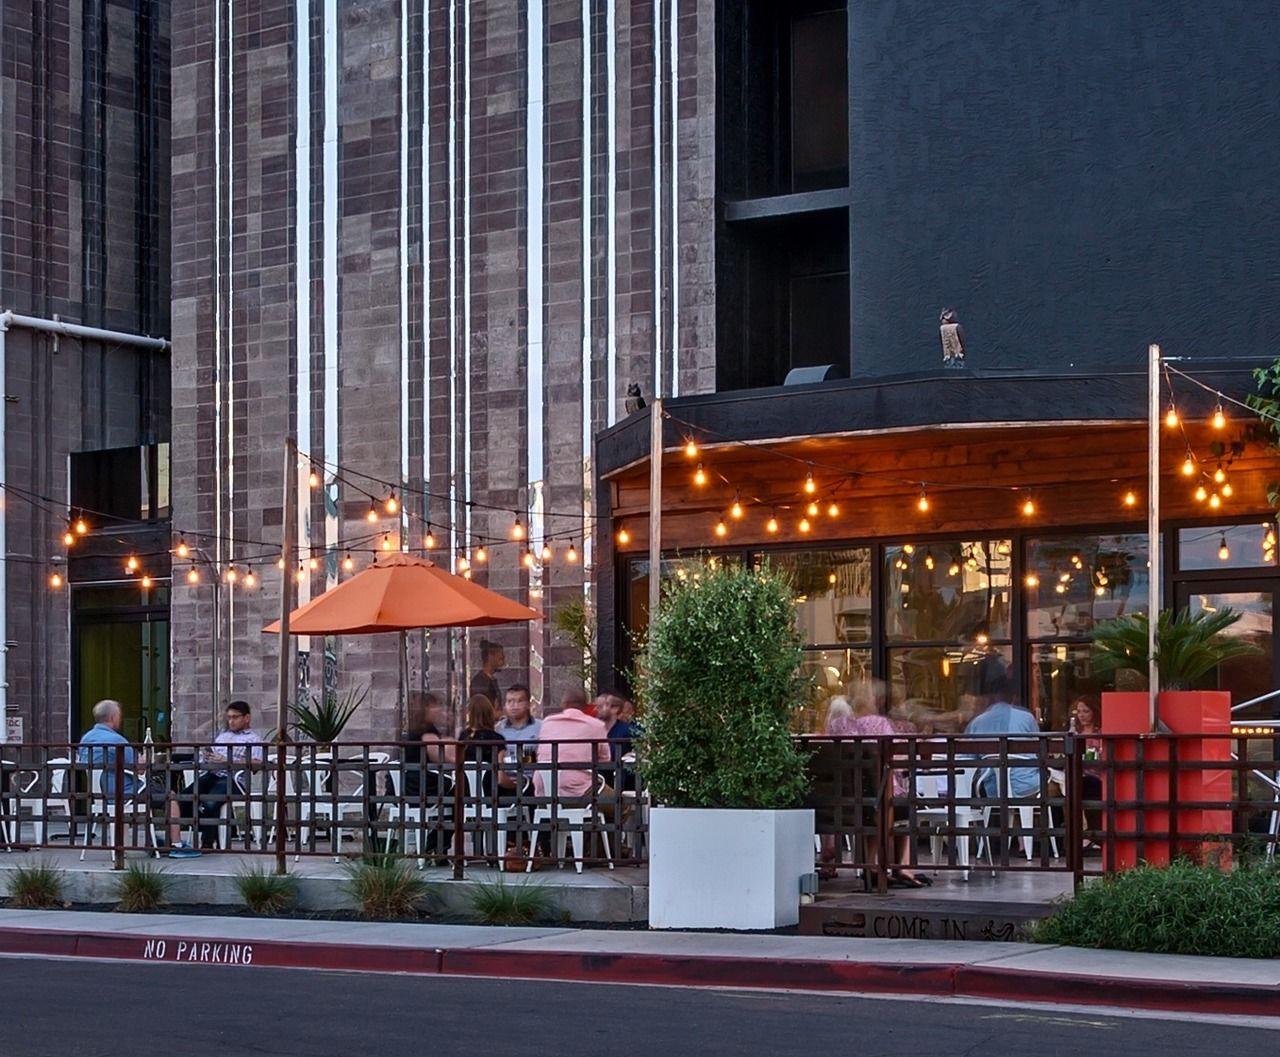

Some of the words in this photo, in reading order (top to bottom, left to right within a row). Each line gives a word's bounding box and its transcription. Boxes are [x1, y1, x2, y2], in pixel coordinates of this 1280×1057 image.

[873, 915, 930, 939] COME
[940, 918, 969, 941] IN
[144, 939, 166, 959] NO
[176, 941, 253, 965] PARKING
